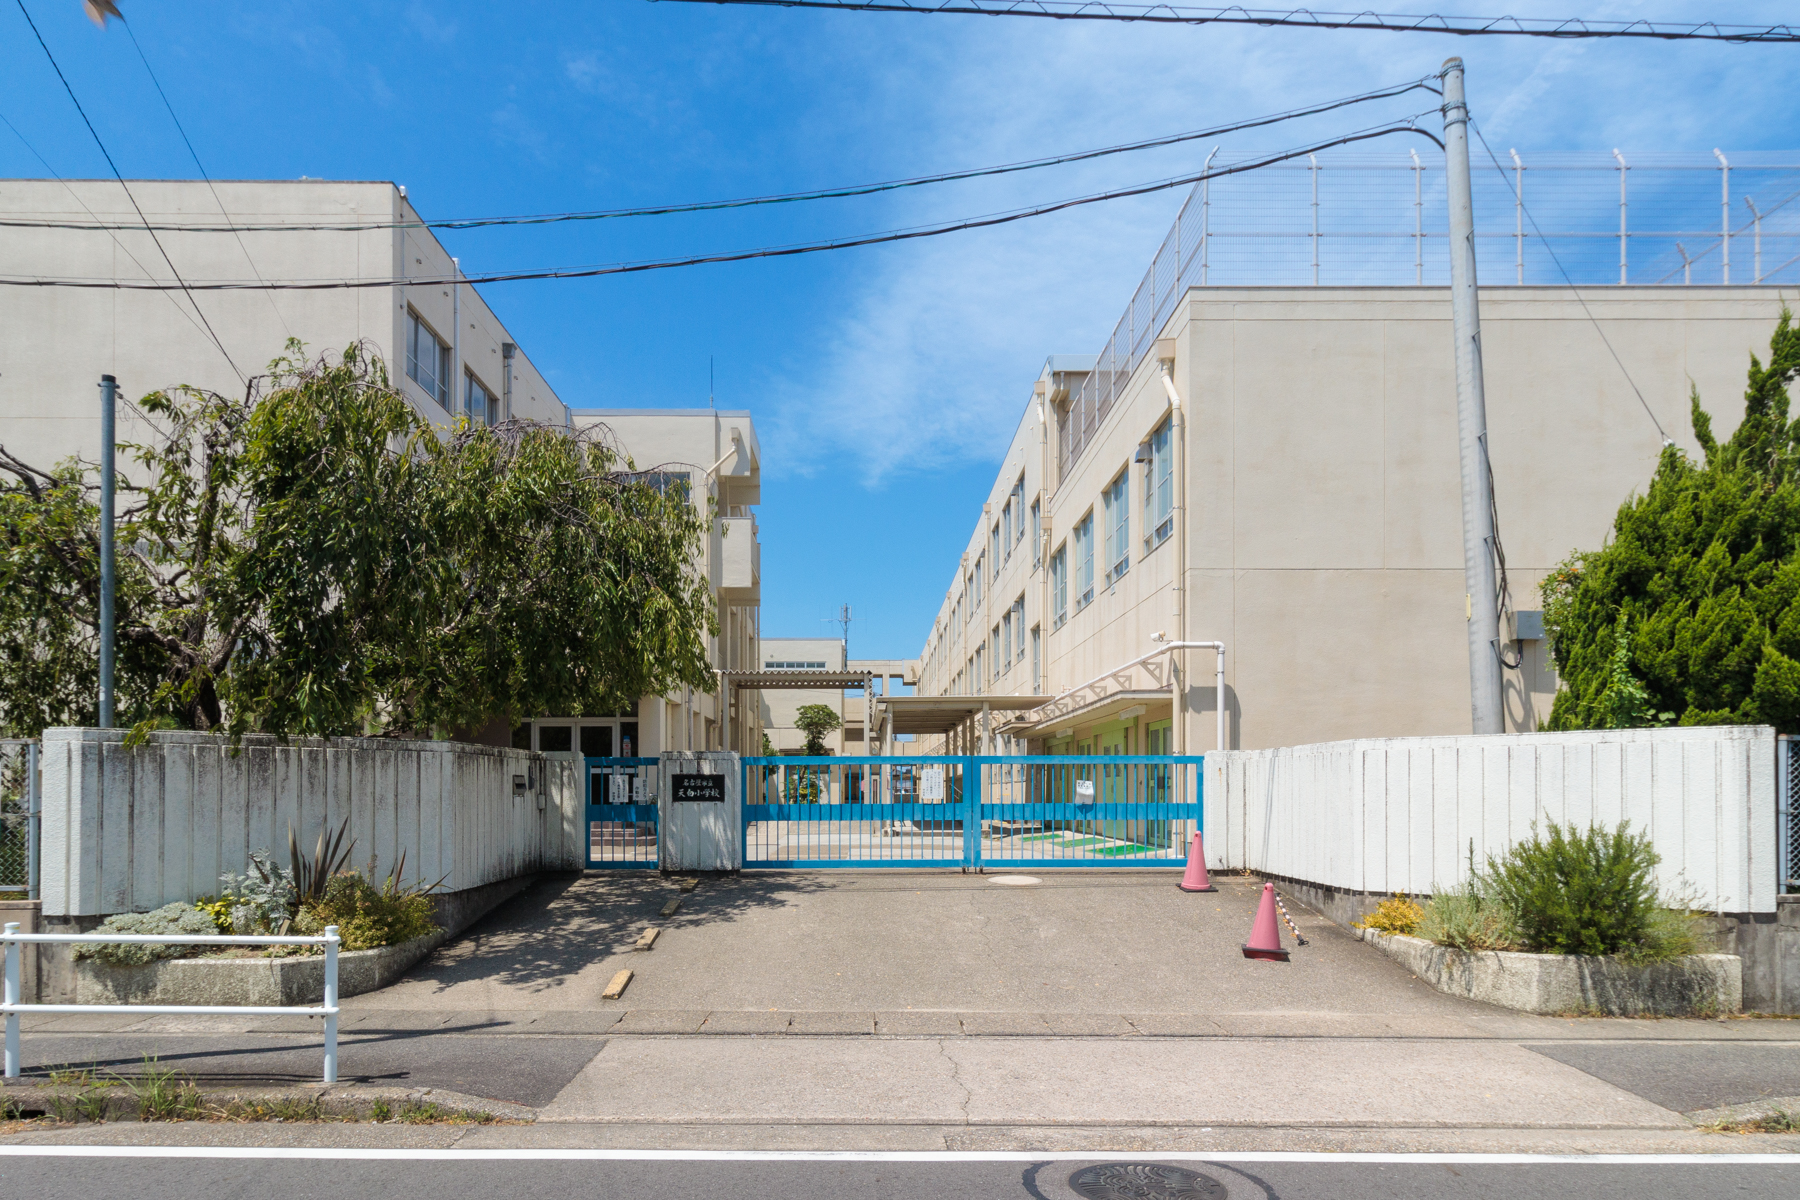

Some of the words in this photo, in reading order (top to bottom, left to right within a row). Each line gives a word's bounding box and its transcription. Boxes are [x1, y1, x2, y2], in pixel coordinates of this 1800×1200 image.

[682, 779, 714, 787] 名古屋市立
[677, 788, 721, 798] 天白小学校
